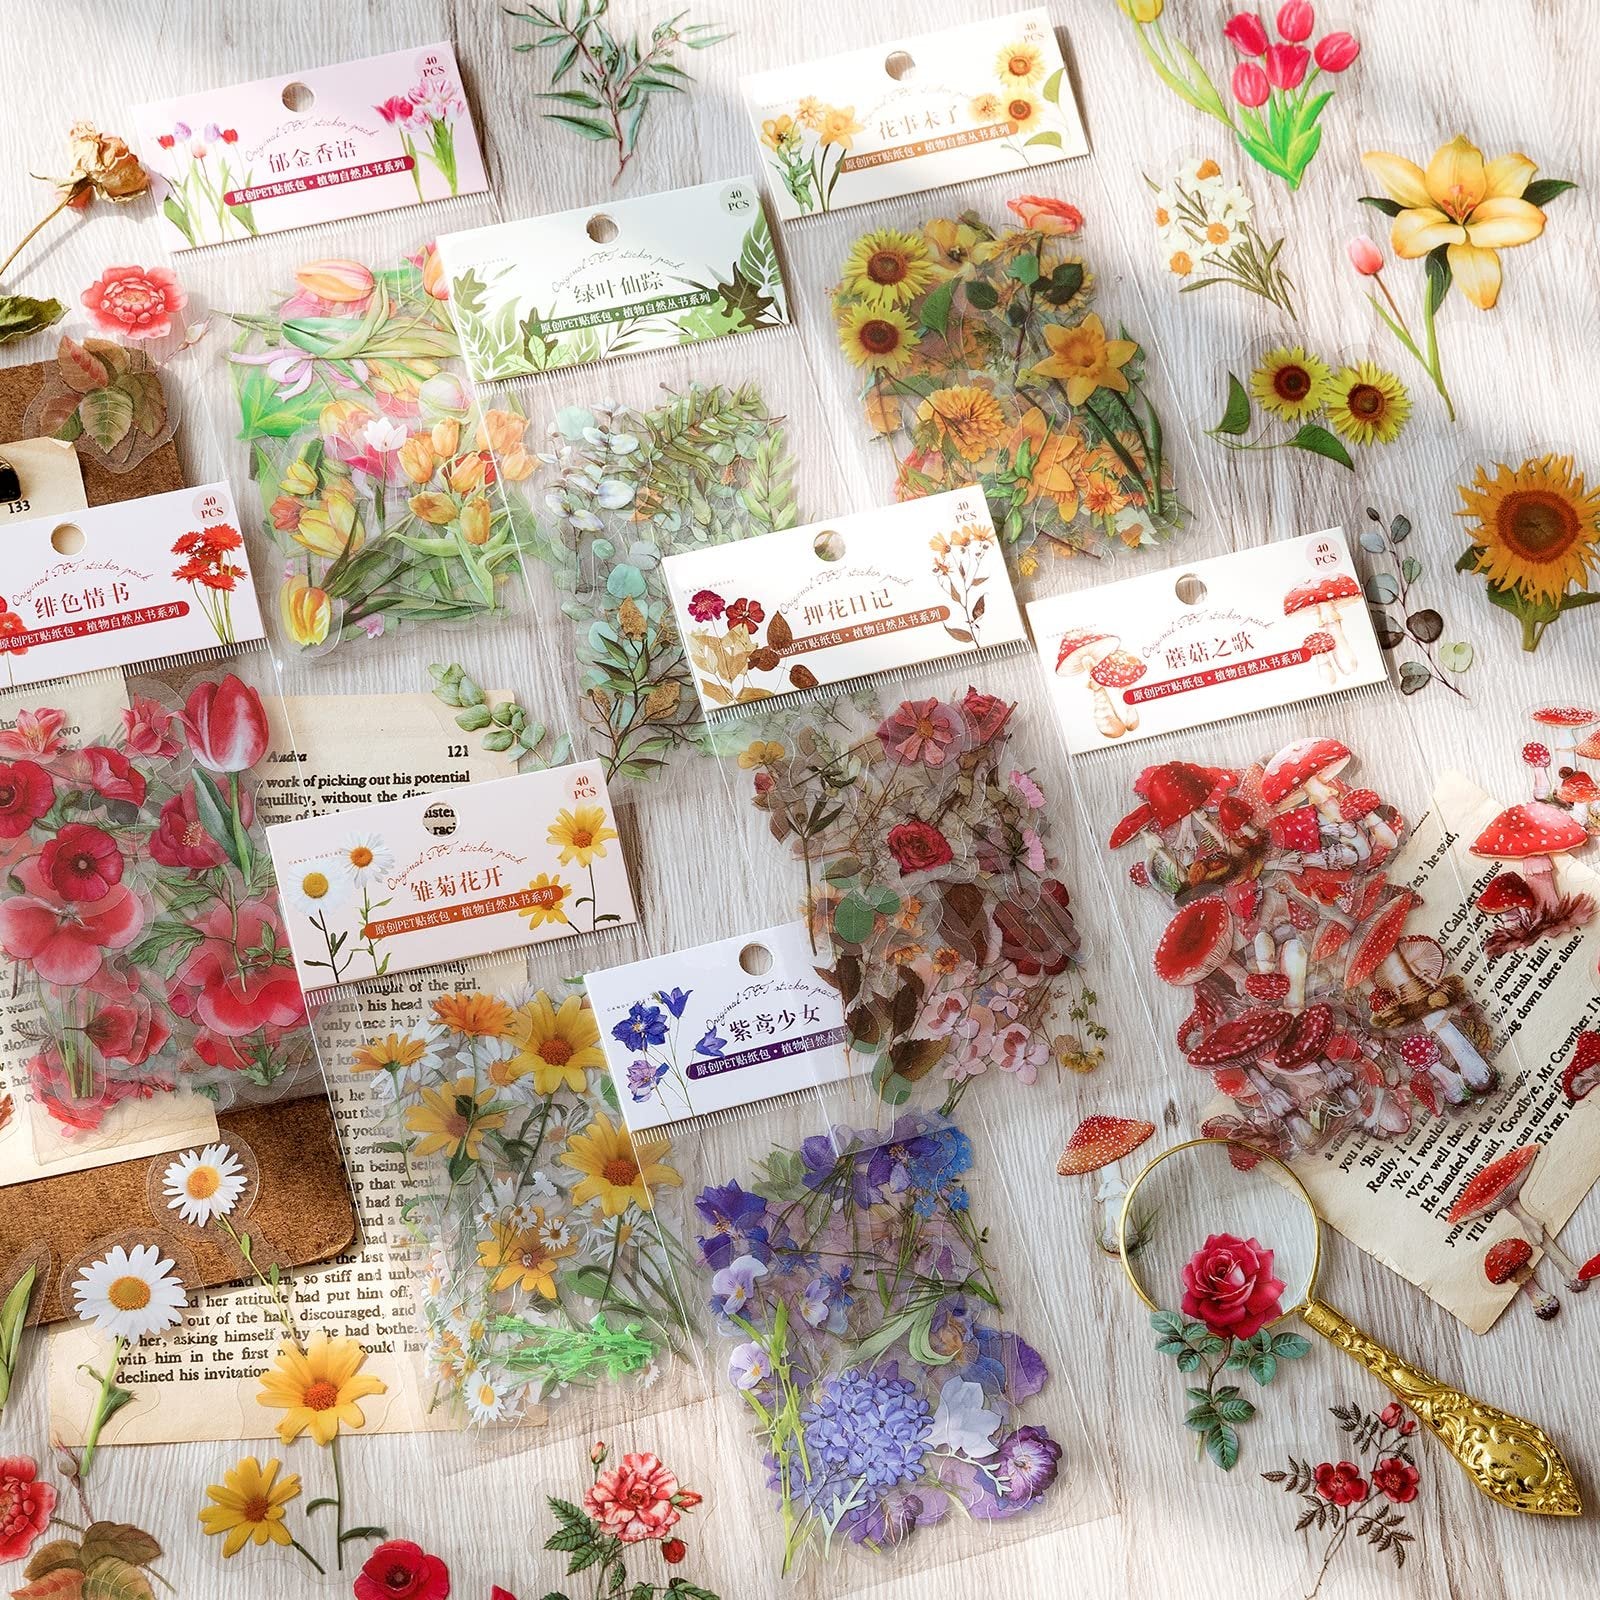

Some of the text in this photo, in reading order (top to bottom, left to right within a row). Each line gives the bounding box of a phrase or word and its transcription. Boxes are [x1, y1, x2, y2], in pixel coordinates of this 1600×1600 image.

[425, 56, 438, 66] 40
[422, 66, 445, 78] PCS
[267, 138, 358, 174] 郁金香语
[730, 190, 742, 200] 40
[728, 199, 750, 211] PCS
[574, 270, 665, 304] 绿叶仙踪
[8, 500, 31, 514] 133
[203, 496, 217, 507] 40
[956, 501, 969, 511] 40
[201, 506, 224, 519] PCS
[955, 511, 977, 524] PCS
[1317, 543, 1329, 553] 40
[1315, 552, 1337, 566] PCS
[35, 583, 131, 619] 绯色情书
[804, 588, 894, 627] 押花日记
[1165, 631, 1255, 670] 蘑菇之歌
[448, 745, 470, 758] 121
[267, 771, 470, 789] work of picking out his potential
[576, 775, 590, 787] 40
[321, 790, 397, 804] without the
[572, 786, 597, 799] PCS
[1422, 854, 1440, 870] he
[411, 866, 504, 904] 雏菊花开
[1437, 928, 1450, 945] of
[1471, 861, 1503, 894] House
[1460, 951, 1480, 975] and
[1473, 974, 1487, 988] at
[1489, 949, 1529, 998] yourself,
[409, 978, 481, 993] of the girl.
[1501, 973, 1533, 1007] Parish
[1516, 990, 1543, 1020] down
[1538, 962, 1562, 990] there
[337, 1000, 363, 1013] into
[368, 1000, 387, 1011] his
[391, 998, 423, 1012] head
[322, 1020, 351, 1033] only
[355, 1019, 386, 1030] once
[729, 1004, 820, 1044] 紫鸢少女
[1481, 1138, 1505, 1164] said,
[1536, 1063, 1556, 1084] Mr
[1549, 1015, 1593, 1064] Crowther.
[1516, 1126, 1534, 1147] can
[1541, 1092, 1558, 1111] me
[1338, 1149, 1359, 1174] you
[1419, 1194, 1440, 1214] He
[1433, 1152, 1469, 1196] handed
[1461, 1134, 1483, 1156] her
[1478, 1115, 1497, 1135] the
[1429, 1146, 1451, 1171] well
[351, 1162, 364, 1173] in
[369, 1160, 407, 1174] being
[1365, 1157, 1400, 1194] Really.
[369, 1178, 395, 1190] that
[366, 1195, 391, 1208] had
[361, 1251, 384, 1263] last
[303, 1269, 382, 1285] so stiff and
[206, 1295, 229, 1308] her
[235, 1292, 289, 1307] attitude
[295, 1290, 320, 1304] had
[327, 1290, 350, 1304] put
[357, 1287, 384, 1300] him
[188, 1303, 417, 1327] out of the discouraged, and
[139, 1323, 370, 1348] her, asking himself why had
[117, 1351, 147, 1367] with
[155, 1351, 182, 1365] him
[190, 1350, 204, 1364] in
[212, 1348, 234, 1362] the
[241, 1347, 269, 1361] first
[116, 1369, 174, 1385] declined
[180, 1367, 199, 1382] his
